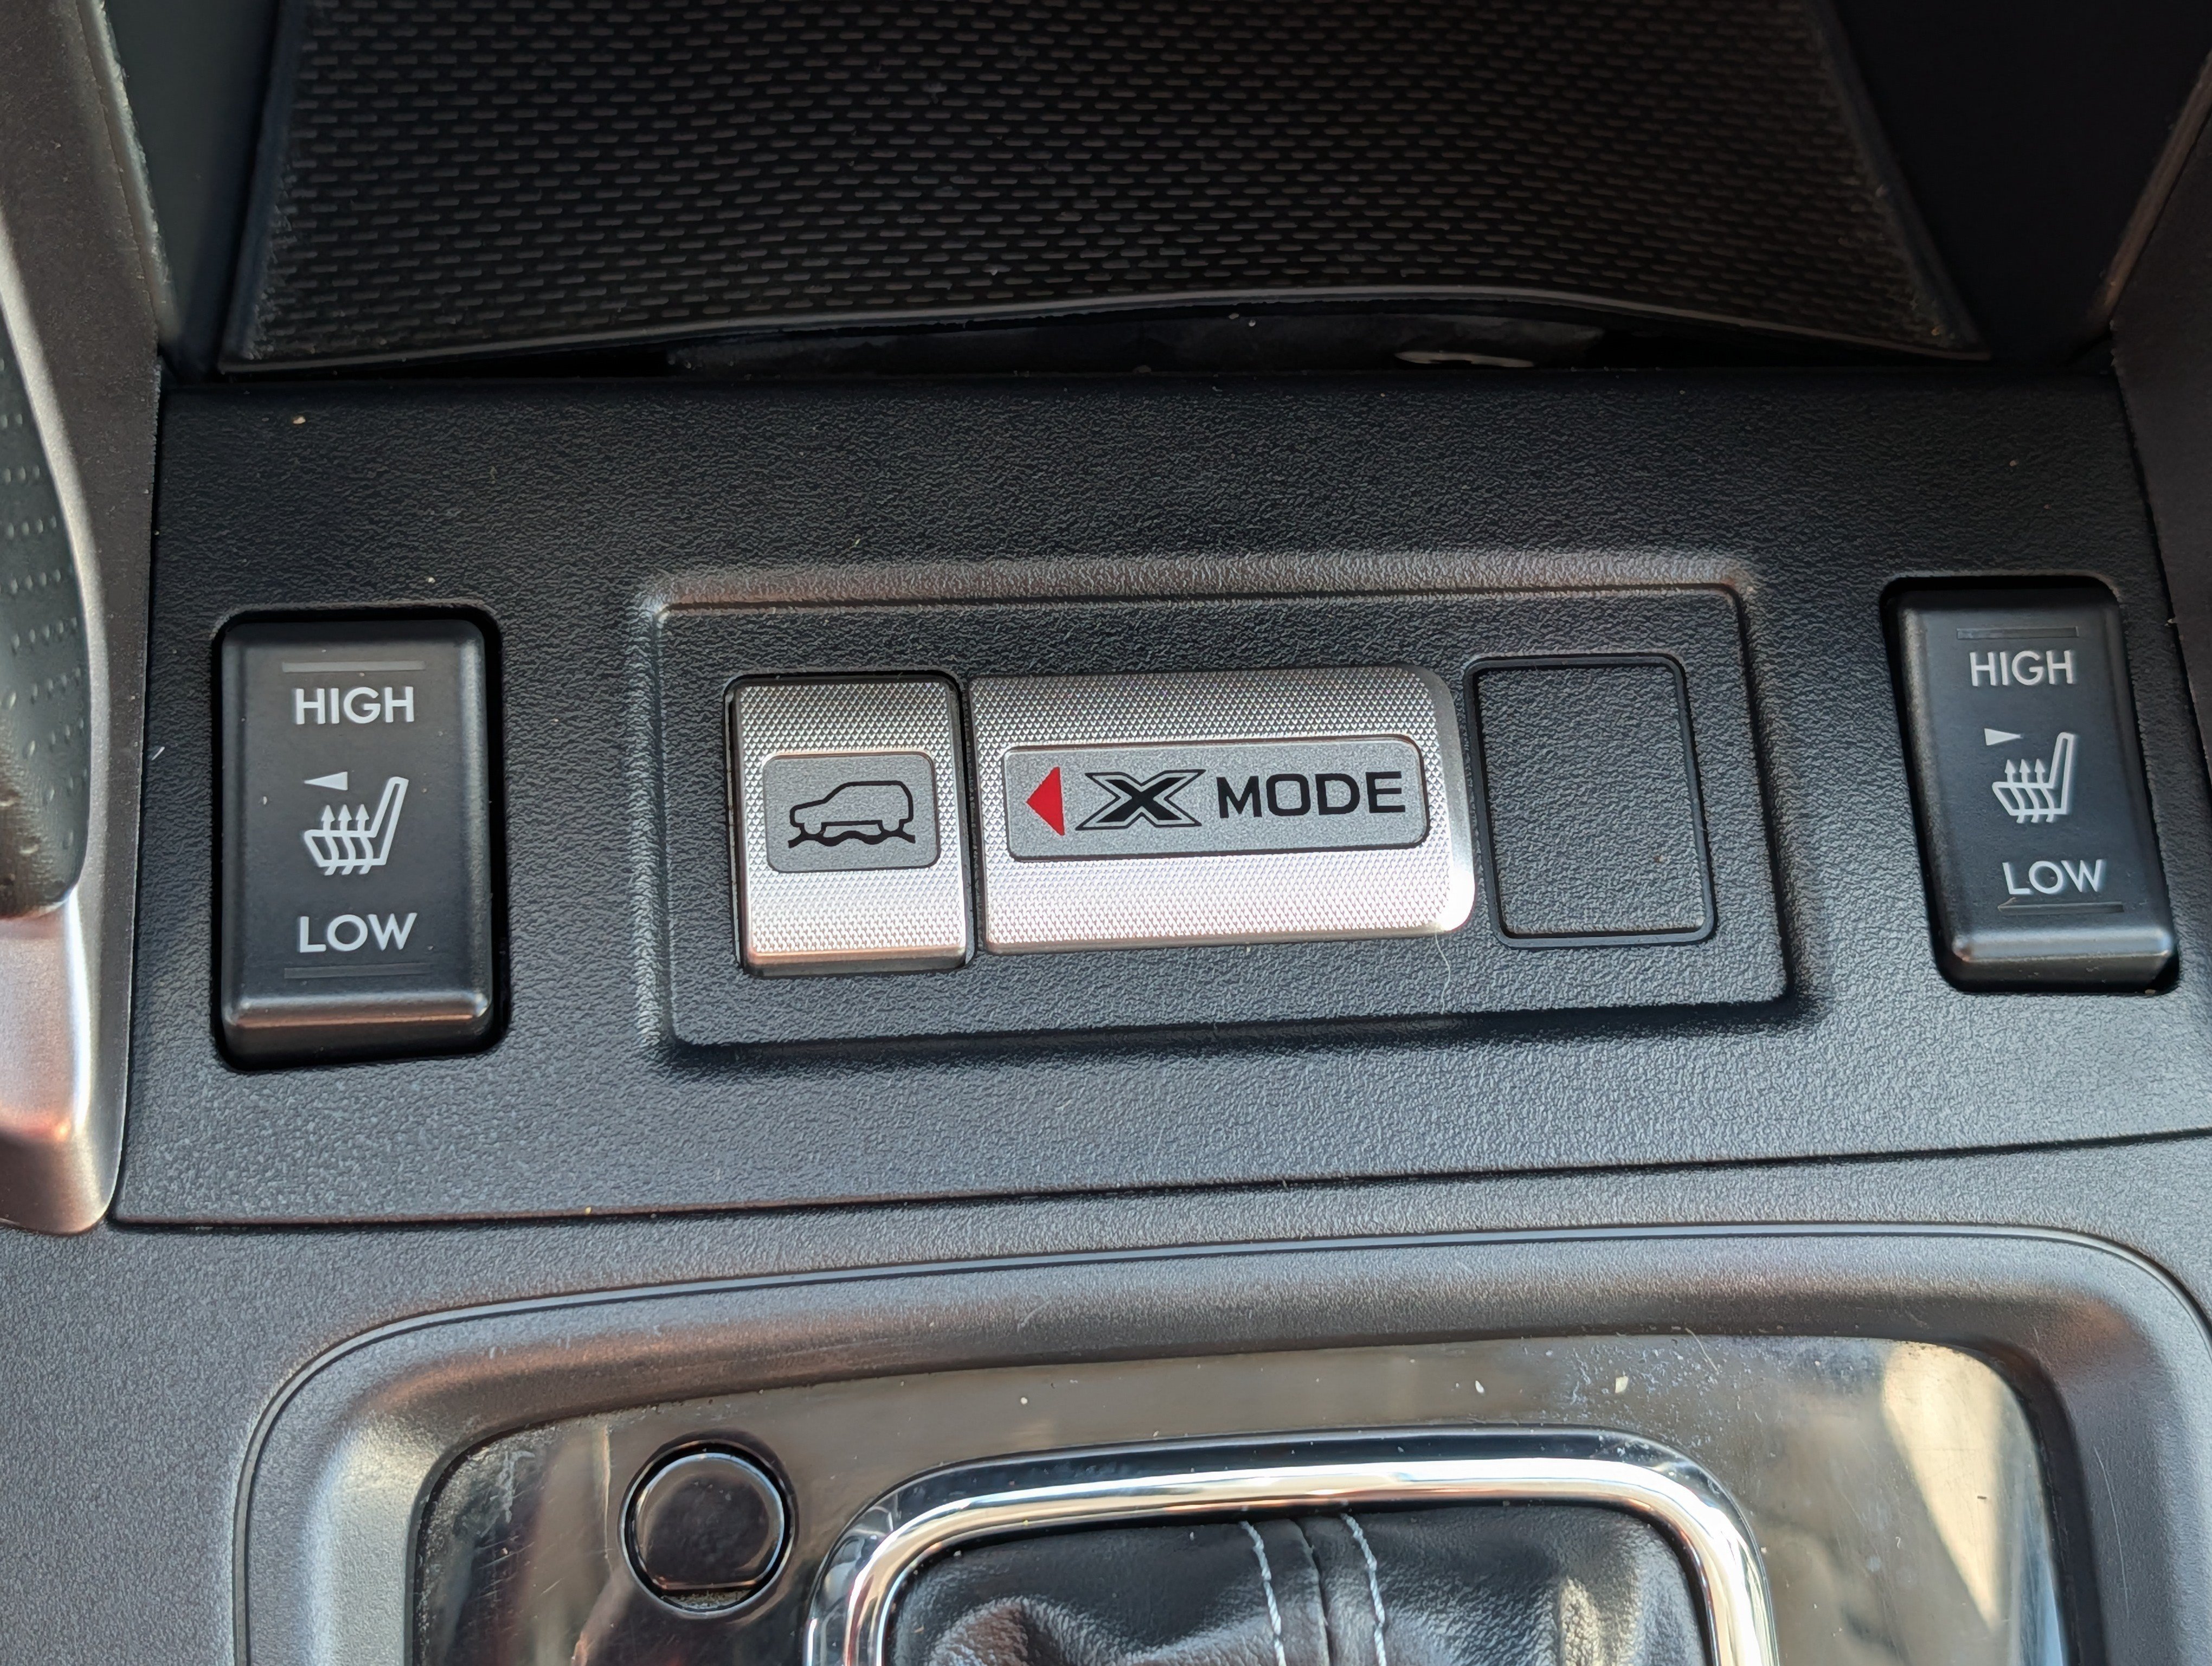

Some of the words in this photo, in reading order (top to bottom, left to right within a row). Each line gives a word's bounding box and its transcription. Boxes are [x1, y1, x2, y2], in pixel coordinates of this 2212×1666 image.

[1969, 650, 2075, 687] HIGH
[294, 686, 415, 725] HIGH
[1075, 769, 1206, 831] X
[1216, 771, 1406, 819] MODE
[2002, 858, 2105, 895] LOW
[298, 912, 418, 953] LOW
